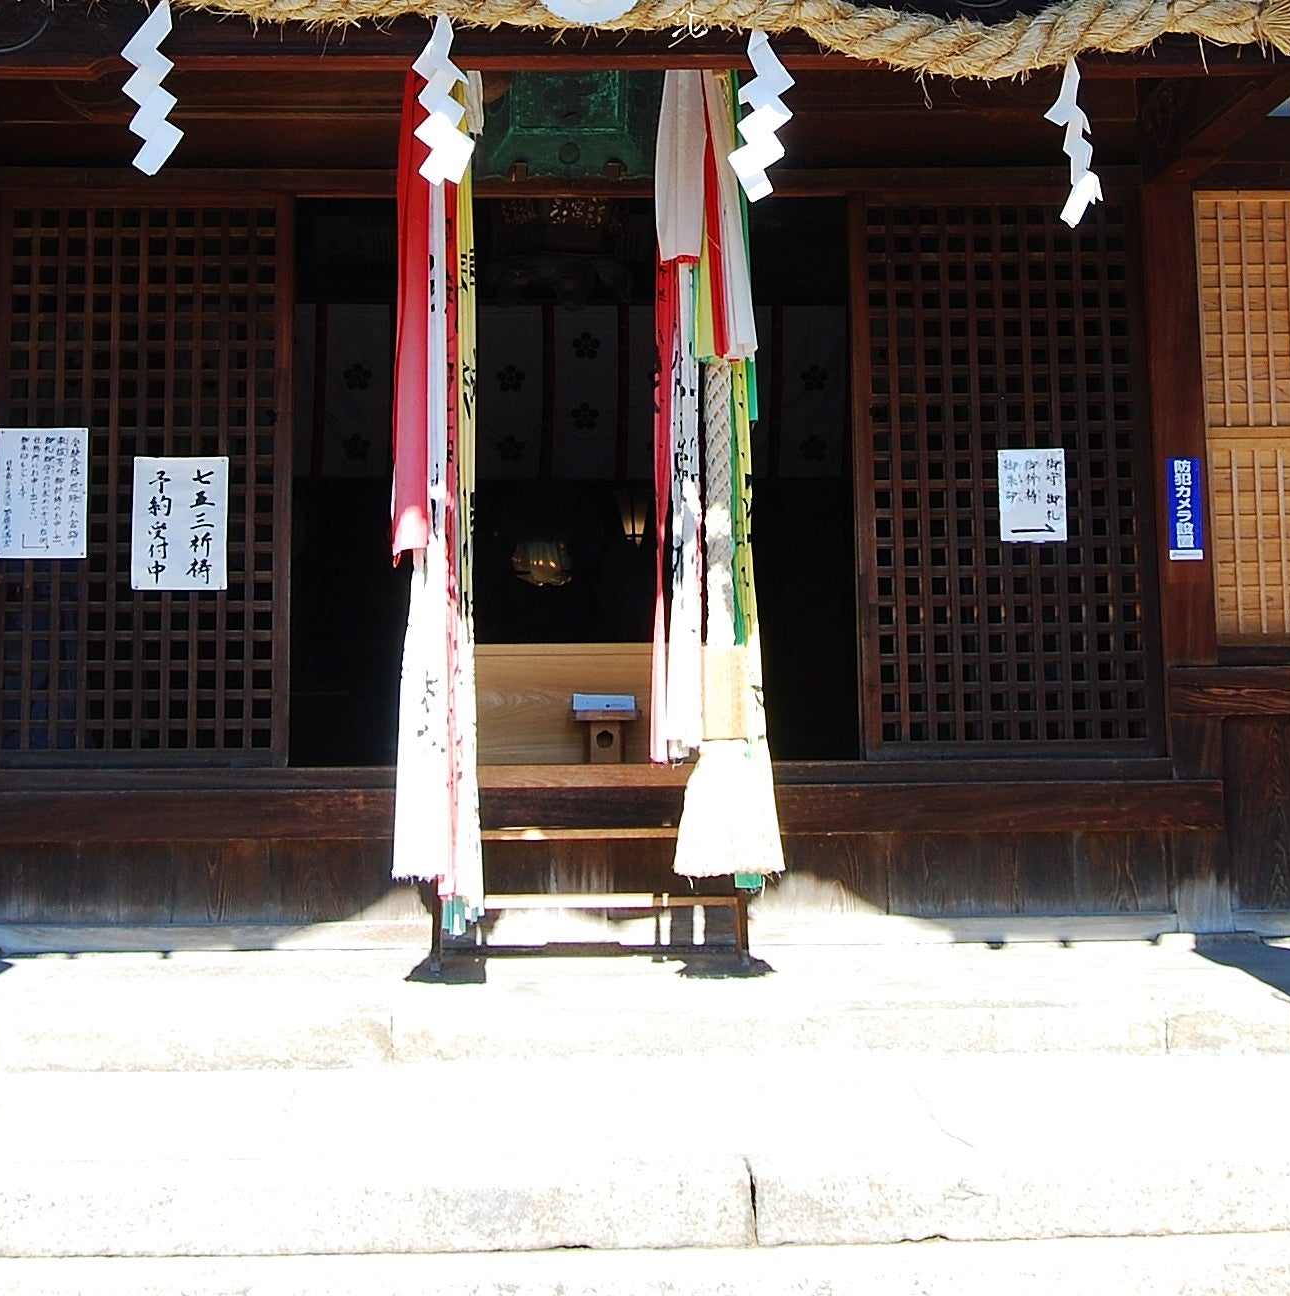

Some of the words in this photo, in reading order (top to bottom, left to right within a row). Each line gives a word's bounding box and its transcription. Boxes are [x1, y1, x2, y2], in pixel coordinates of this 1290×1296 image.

[148, 470, 172, 584] 予約受付中
[1173, 459, 1195, 548] 防犯カメラ設置
